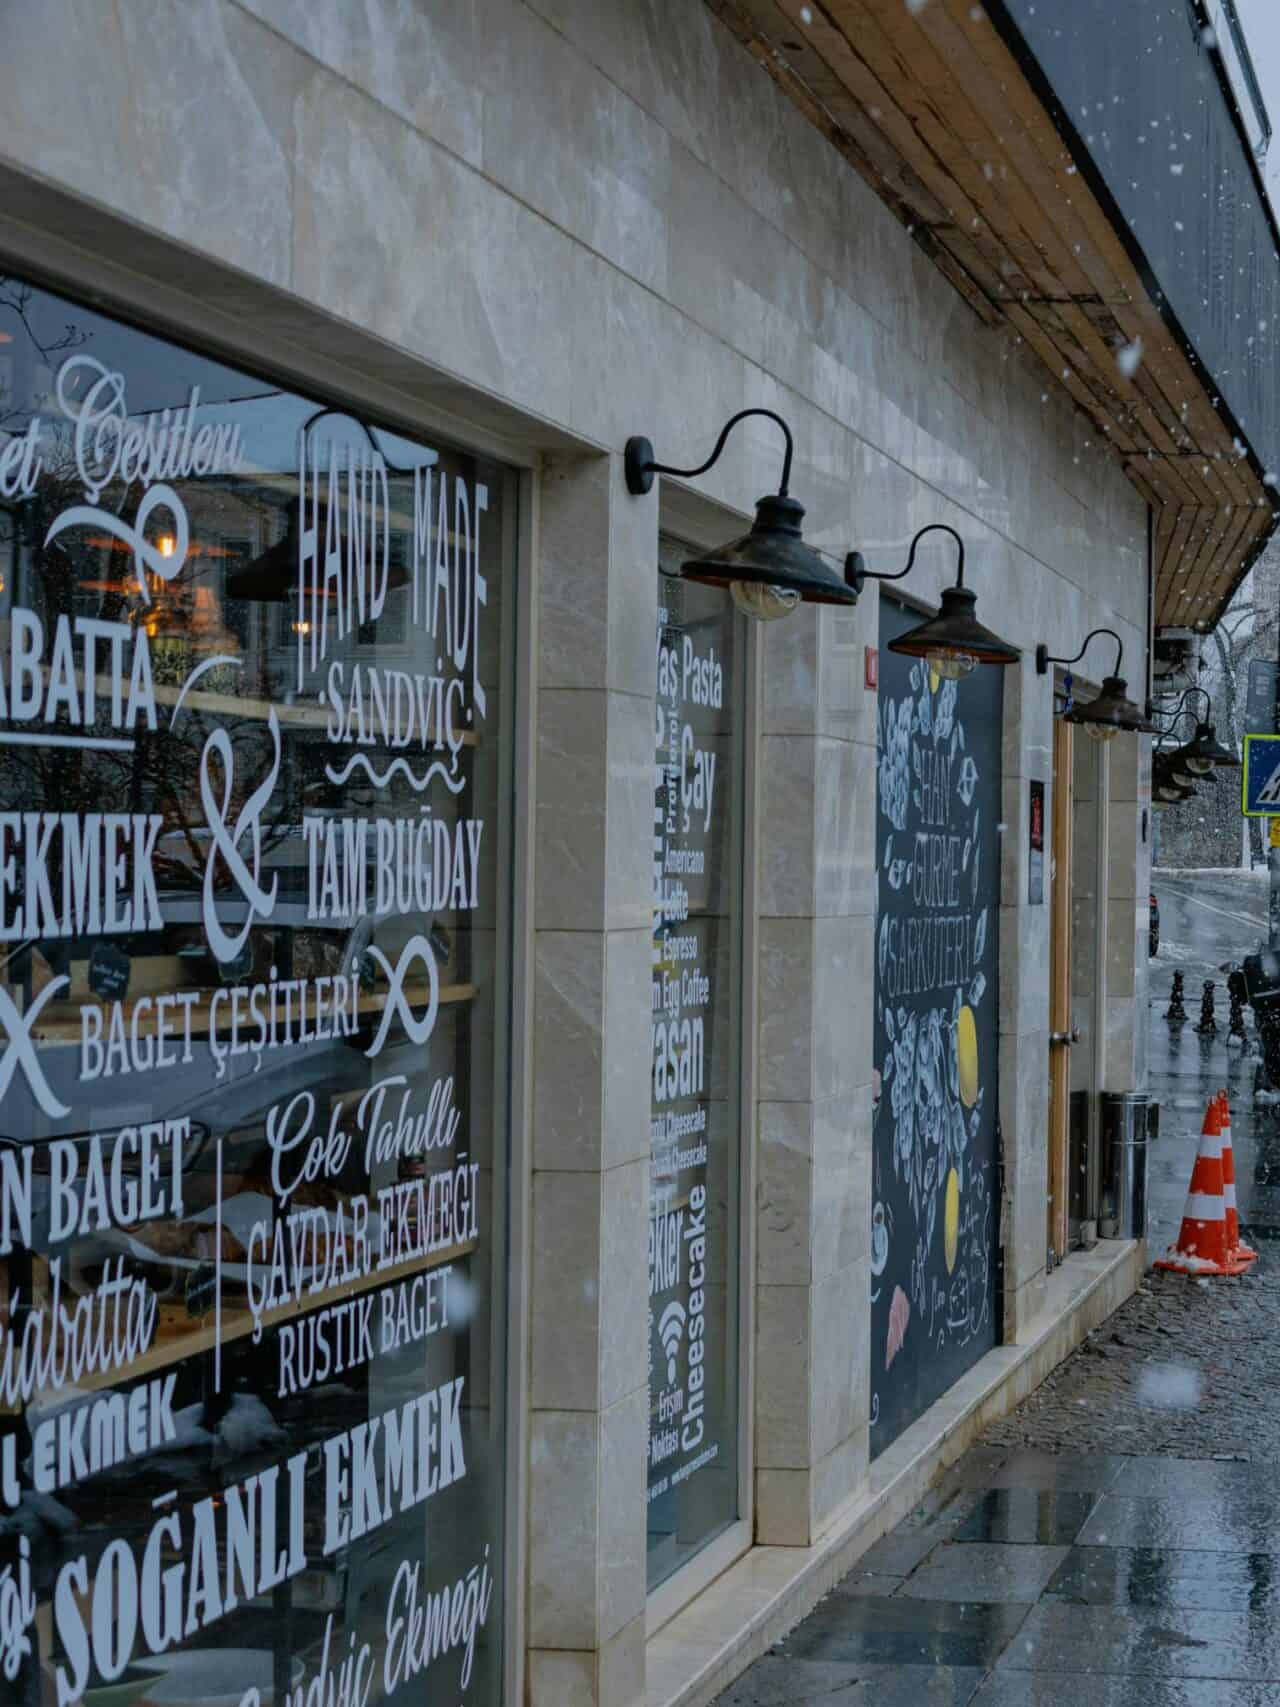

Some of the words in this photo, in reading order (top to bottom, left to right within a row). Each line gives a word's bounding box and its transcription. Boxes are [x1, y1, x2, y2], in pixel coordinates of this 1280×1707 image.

[296, 424, 389, 694] HAND
[411, 462, 488, 719] MADE
[0, 606, 158, 731] BATTA
[682, 634, 722, 711] Pasta
[680, 723, 716, 833] Çay
[302, 816, 368, 920] TAM
[375, 805, 485, 916] BUĞDAY
[663, 928, 698, 967] Espresso
[663, 969, 680, 1018] Egg
[681, 966, 710, 1005] Coffee
[79, 991, 200, 1082] BAGET
[209, 958, 362, 1079] ÇEŞİTLERİ
[651, 1012, 705, 1103] asan
[48, 1117, 191, 1244] BAGET
[265, 1090, 353, 1210] Çok
[0, 1254, 158, 1407] iabatta
[247, 1193, 372, 1345] ÇAVDAR
[681, 1183, 706, 1453] Cheesecake
[277, 1288, 375, 1398] RUSTİK
[380, 1265, 453, 1356] BAGET
[32, 1372, 179, 1495] EKMEK
[54, 1450, 308, 1707] SOĞANLI
[322, 1375, 467, 1557] EKMEK
[383, 1542, 494, 1696] Ekmeği
